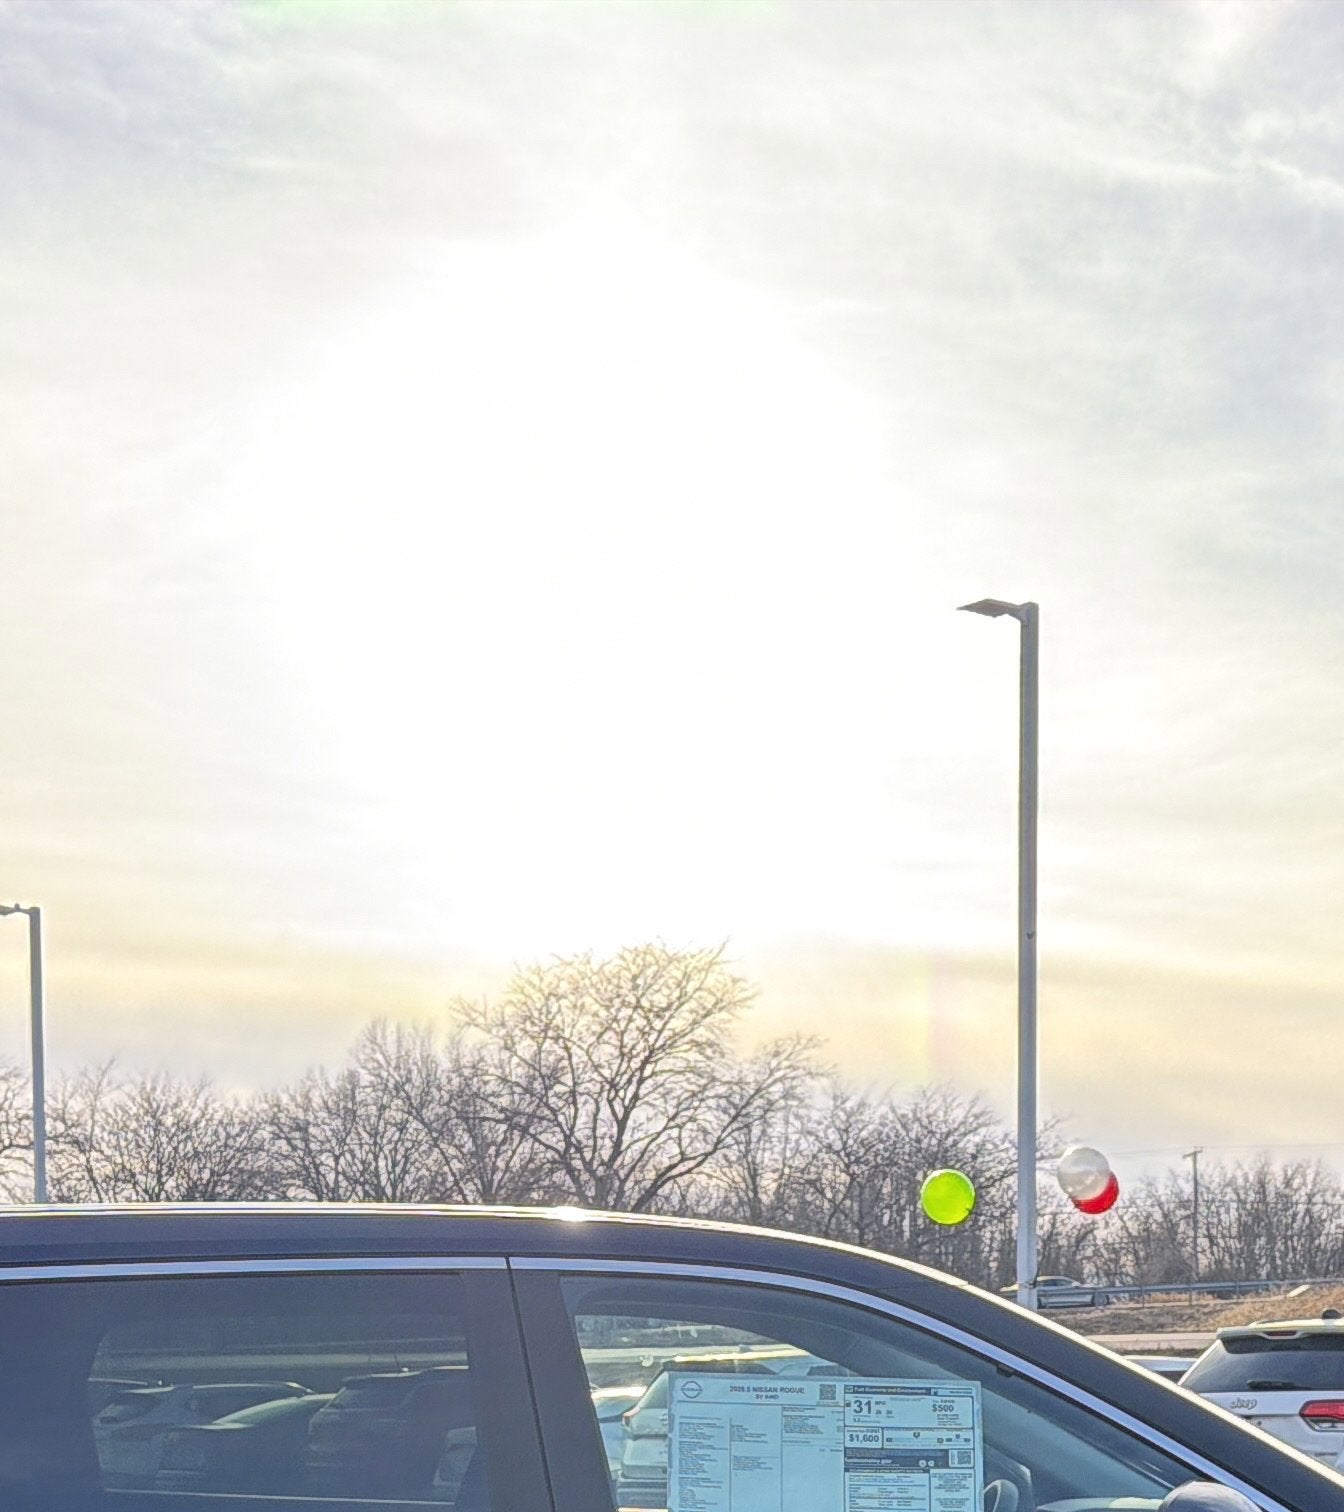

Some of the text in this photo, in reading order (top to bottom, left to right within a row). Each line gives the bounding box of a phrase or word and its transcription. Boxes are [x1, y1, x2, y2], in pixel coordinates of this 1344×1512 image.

[752, 1386, 778, 1394] NISSAN
[853, 1400, 872, 1414] 31
[932, 1403, 954, 1413] $500
[1231, 1397, 1258, 1410] Jeep
[849, 1433, 880, 1444] $1,600
